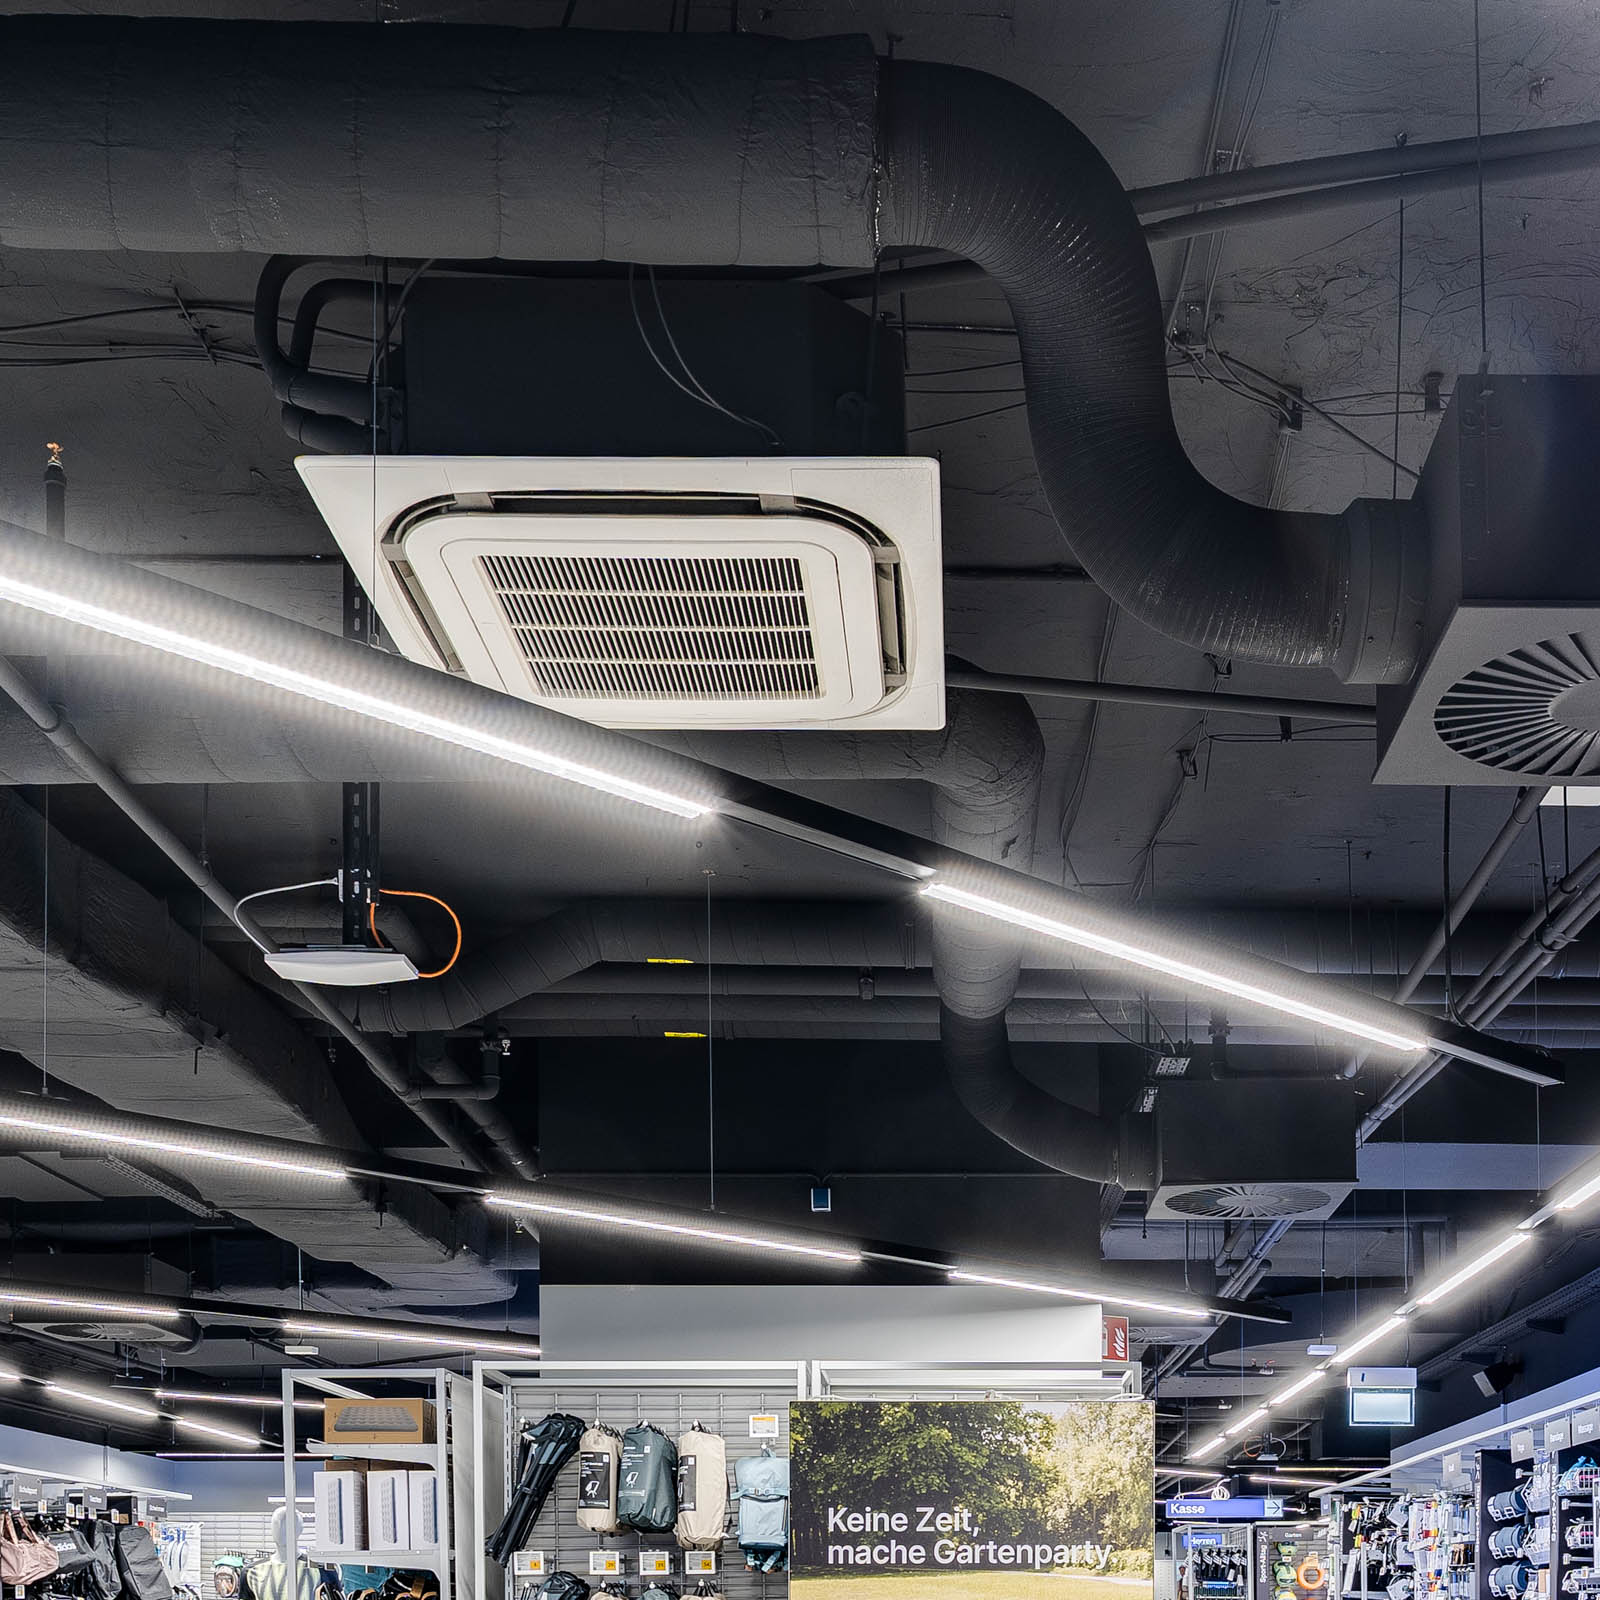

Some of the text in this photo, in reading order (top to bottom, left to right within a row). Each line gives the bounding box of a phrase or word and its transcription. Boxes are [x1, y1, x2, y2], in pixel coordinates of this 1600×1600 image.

[827, 1506, 979, 1537] Keine Zeit,
[1170, 1504, 1206, 1514] Kasse
[827, 1540, 1118, 1570] mache Gartenparty.
